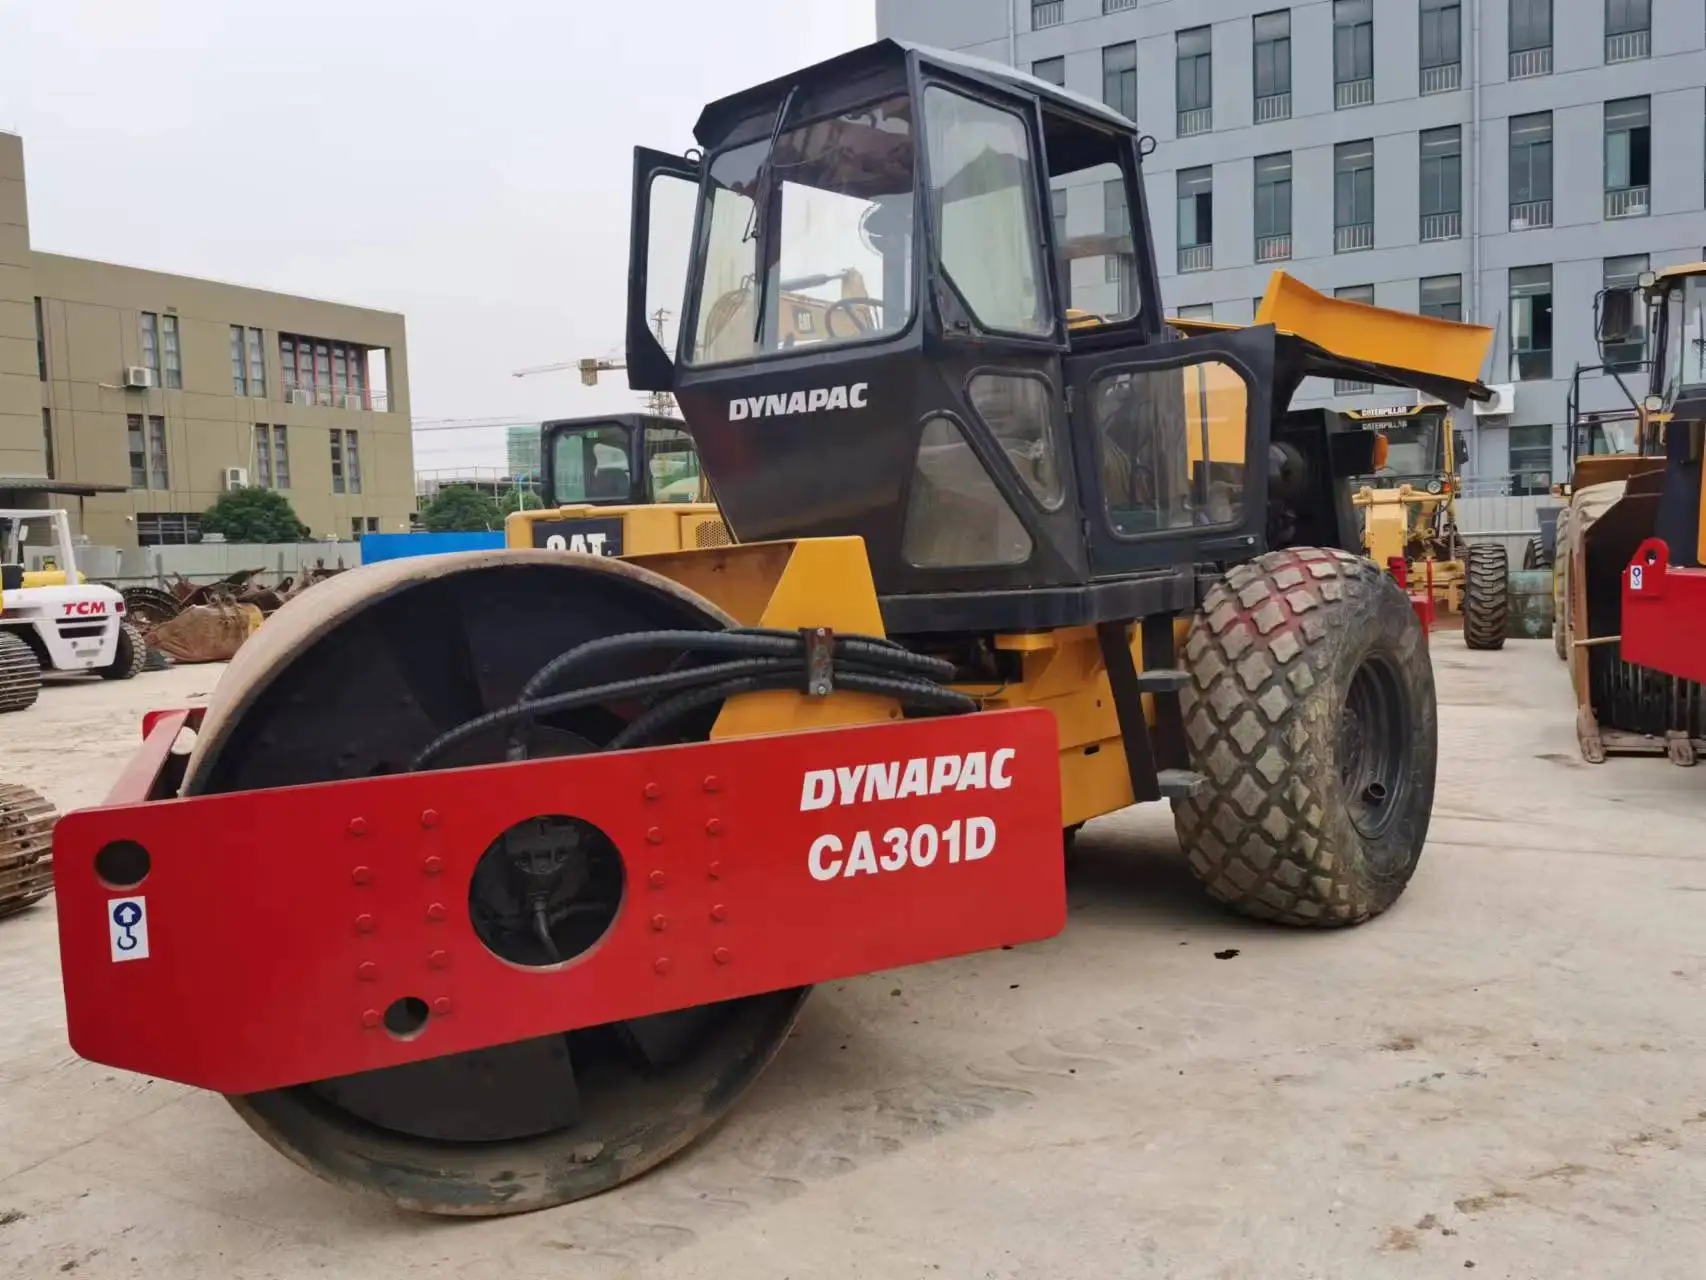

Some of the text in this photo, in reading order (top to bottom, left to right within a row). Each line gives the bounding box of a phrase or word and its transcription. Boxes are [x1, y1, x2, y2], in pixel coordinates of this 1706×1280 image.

[729, 382, 868, 422] DYNAPAC
[63, 601, 106, 615] TCM
[800, 748, 1016, 812] DYNAPAC
[808, 816, 997, 881] CA301D
